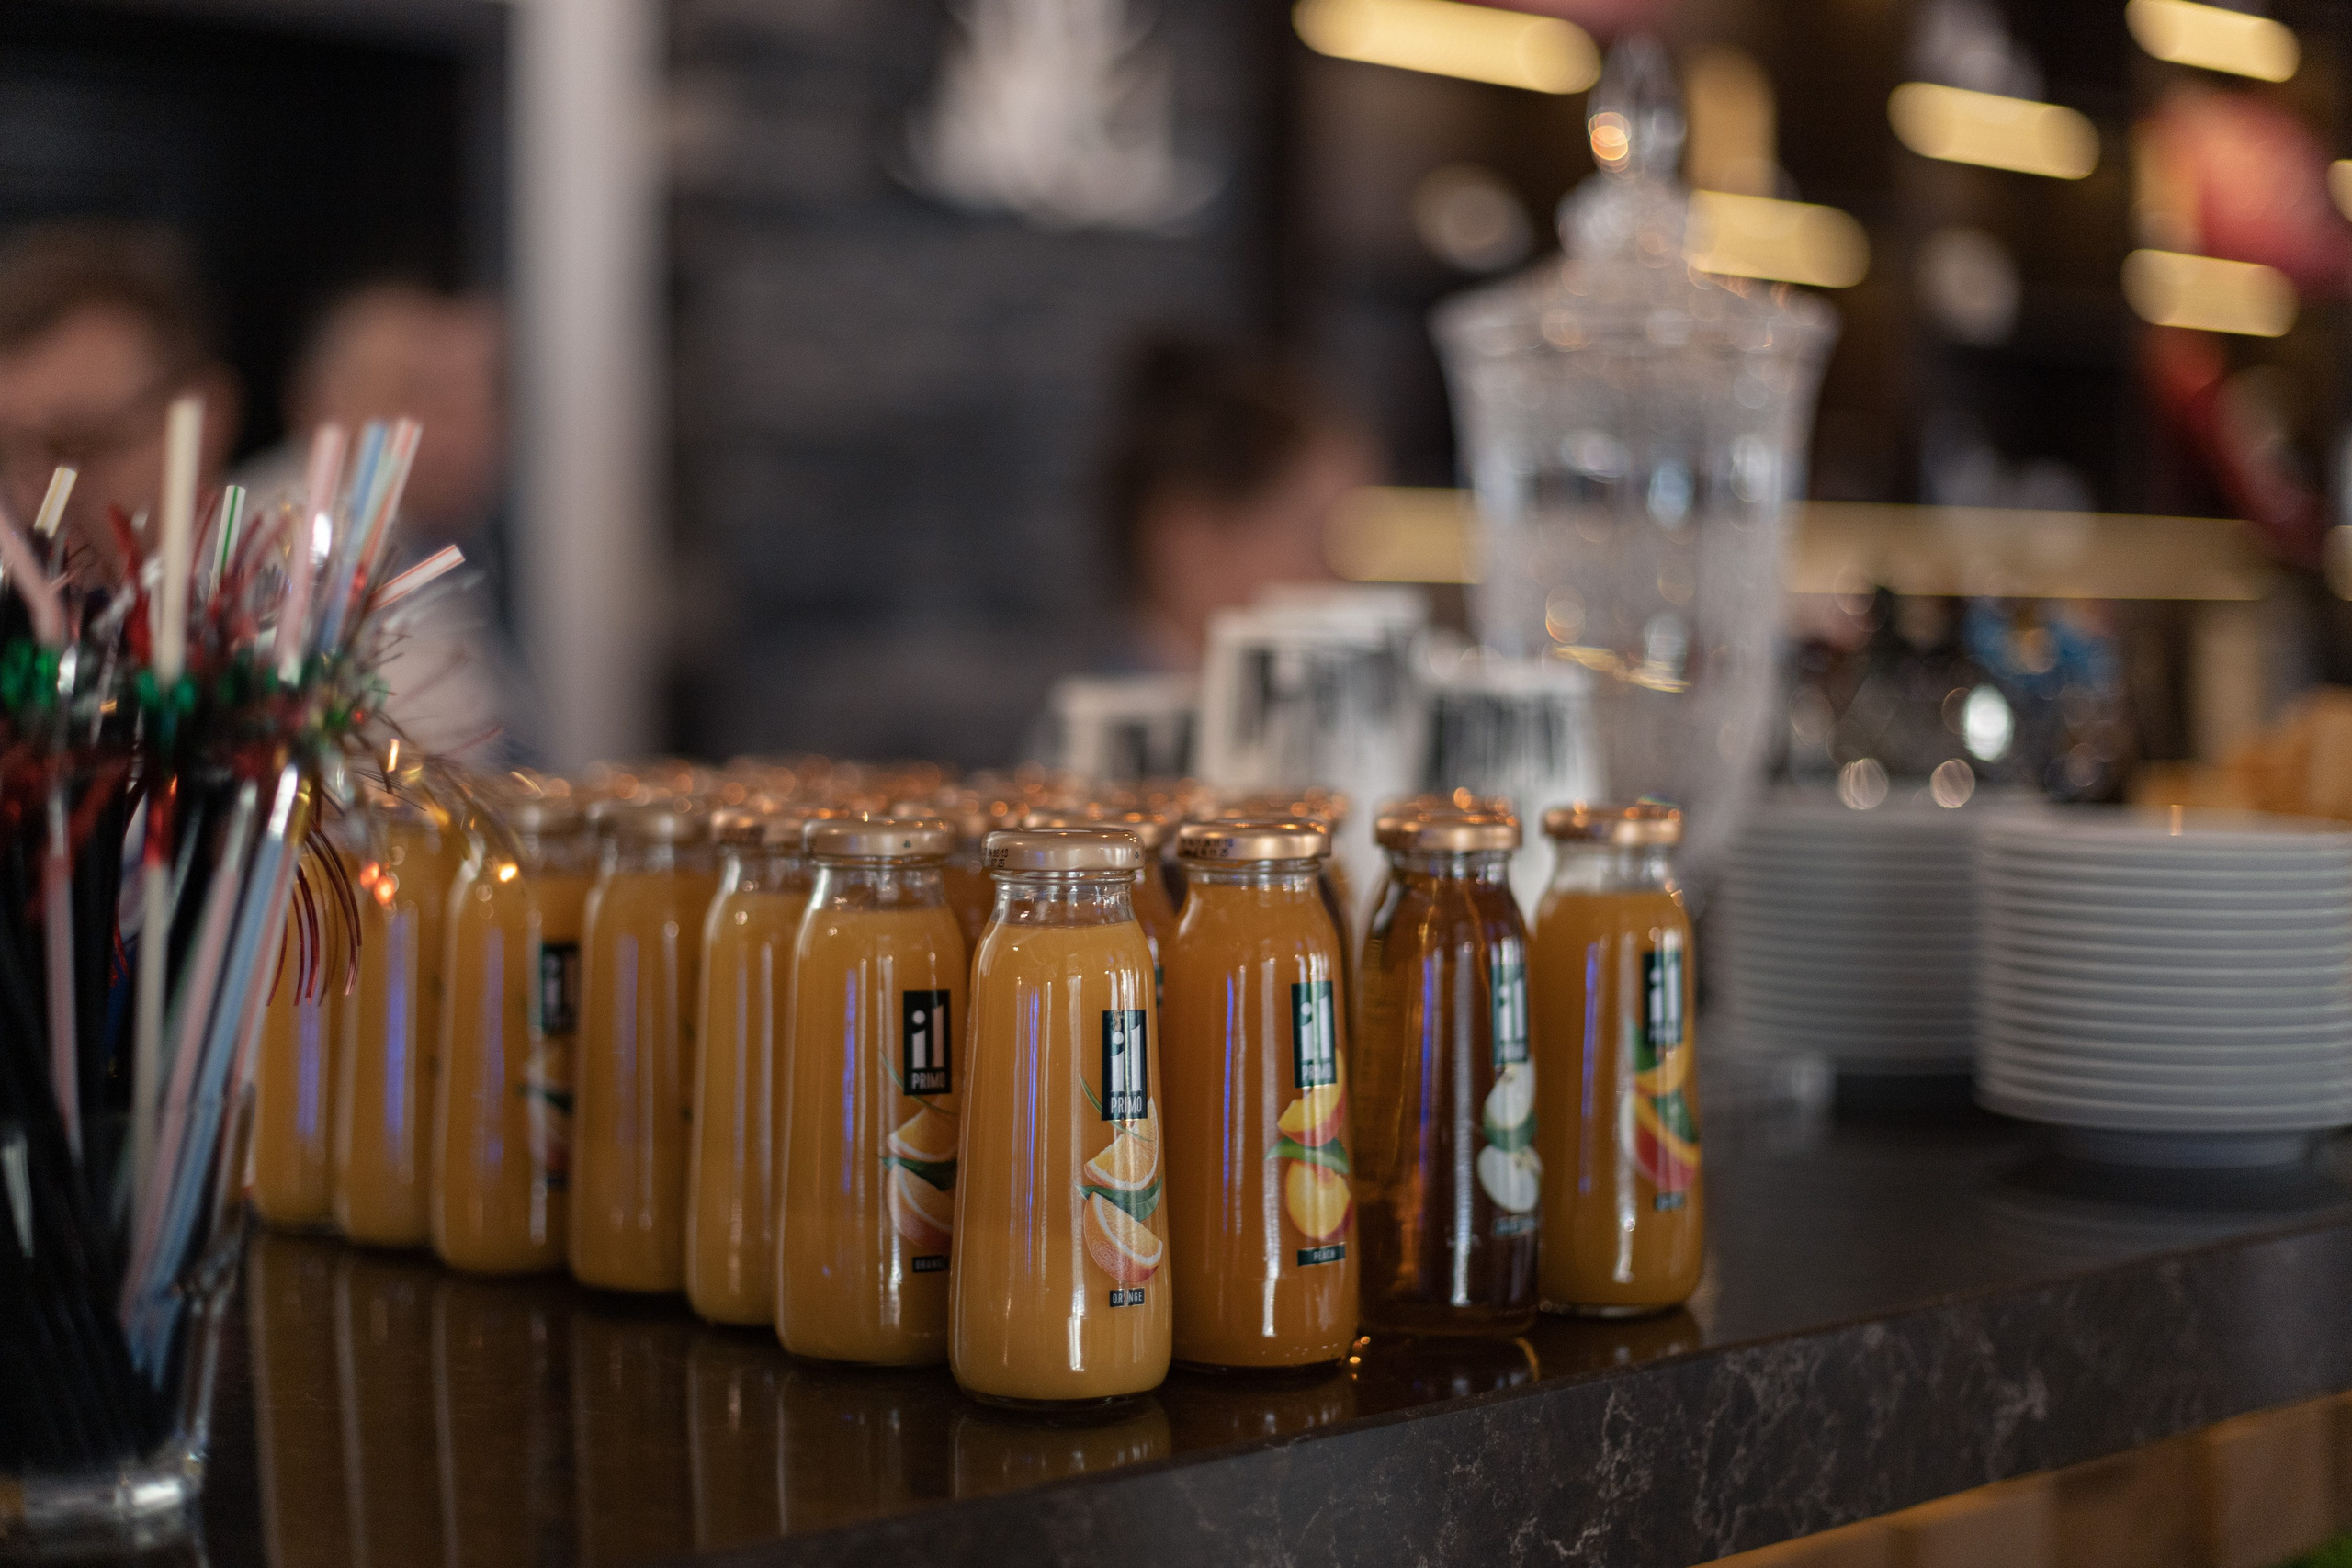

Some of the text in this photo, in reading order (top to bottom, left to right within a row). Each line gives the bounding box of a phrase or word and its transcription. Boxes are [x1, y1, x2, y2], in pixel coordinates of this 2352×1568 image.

[911, 1004, 944, 1069] il
[1299, 994, 1331, 1060] il
[1111, 1023, 1141, 1092] il
[910, 1071, 946, 1089] PRIMO
[1110, 1095, 1143, 1113] PRIMO
[1112, 1291, 1143, 1303] ORNGE
